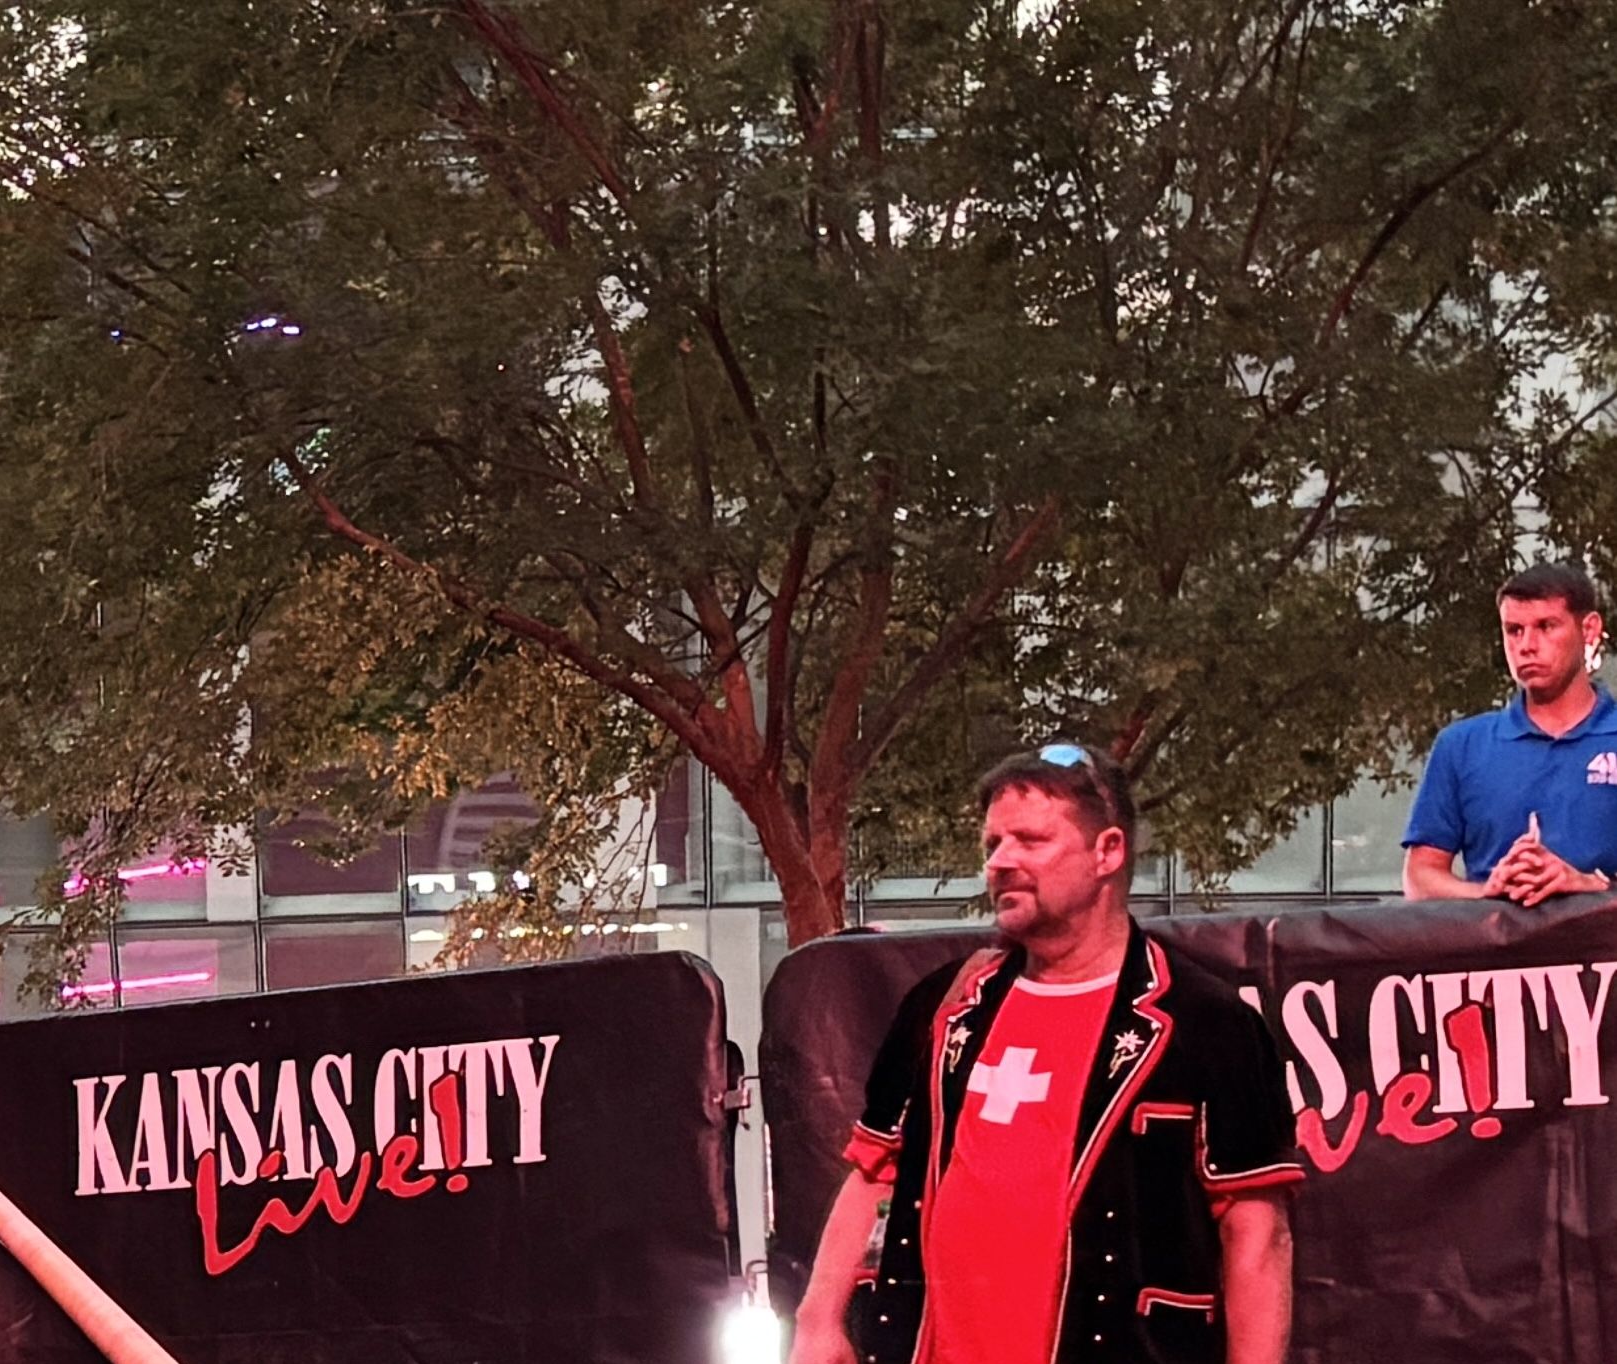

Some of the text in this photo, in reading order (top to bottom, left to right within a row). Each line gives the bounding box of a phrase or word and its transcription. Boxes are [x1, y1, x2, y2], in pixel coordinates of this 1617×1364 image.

[72, 1035, 561, 1196] KANSAS CITY
[1296, 1003, 1502, 1173] ve!
[1369, 961, 1617, 1114] CITY
[196, 1073, 469, 1276] Live!
